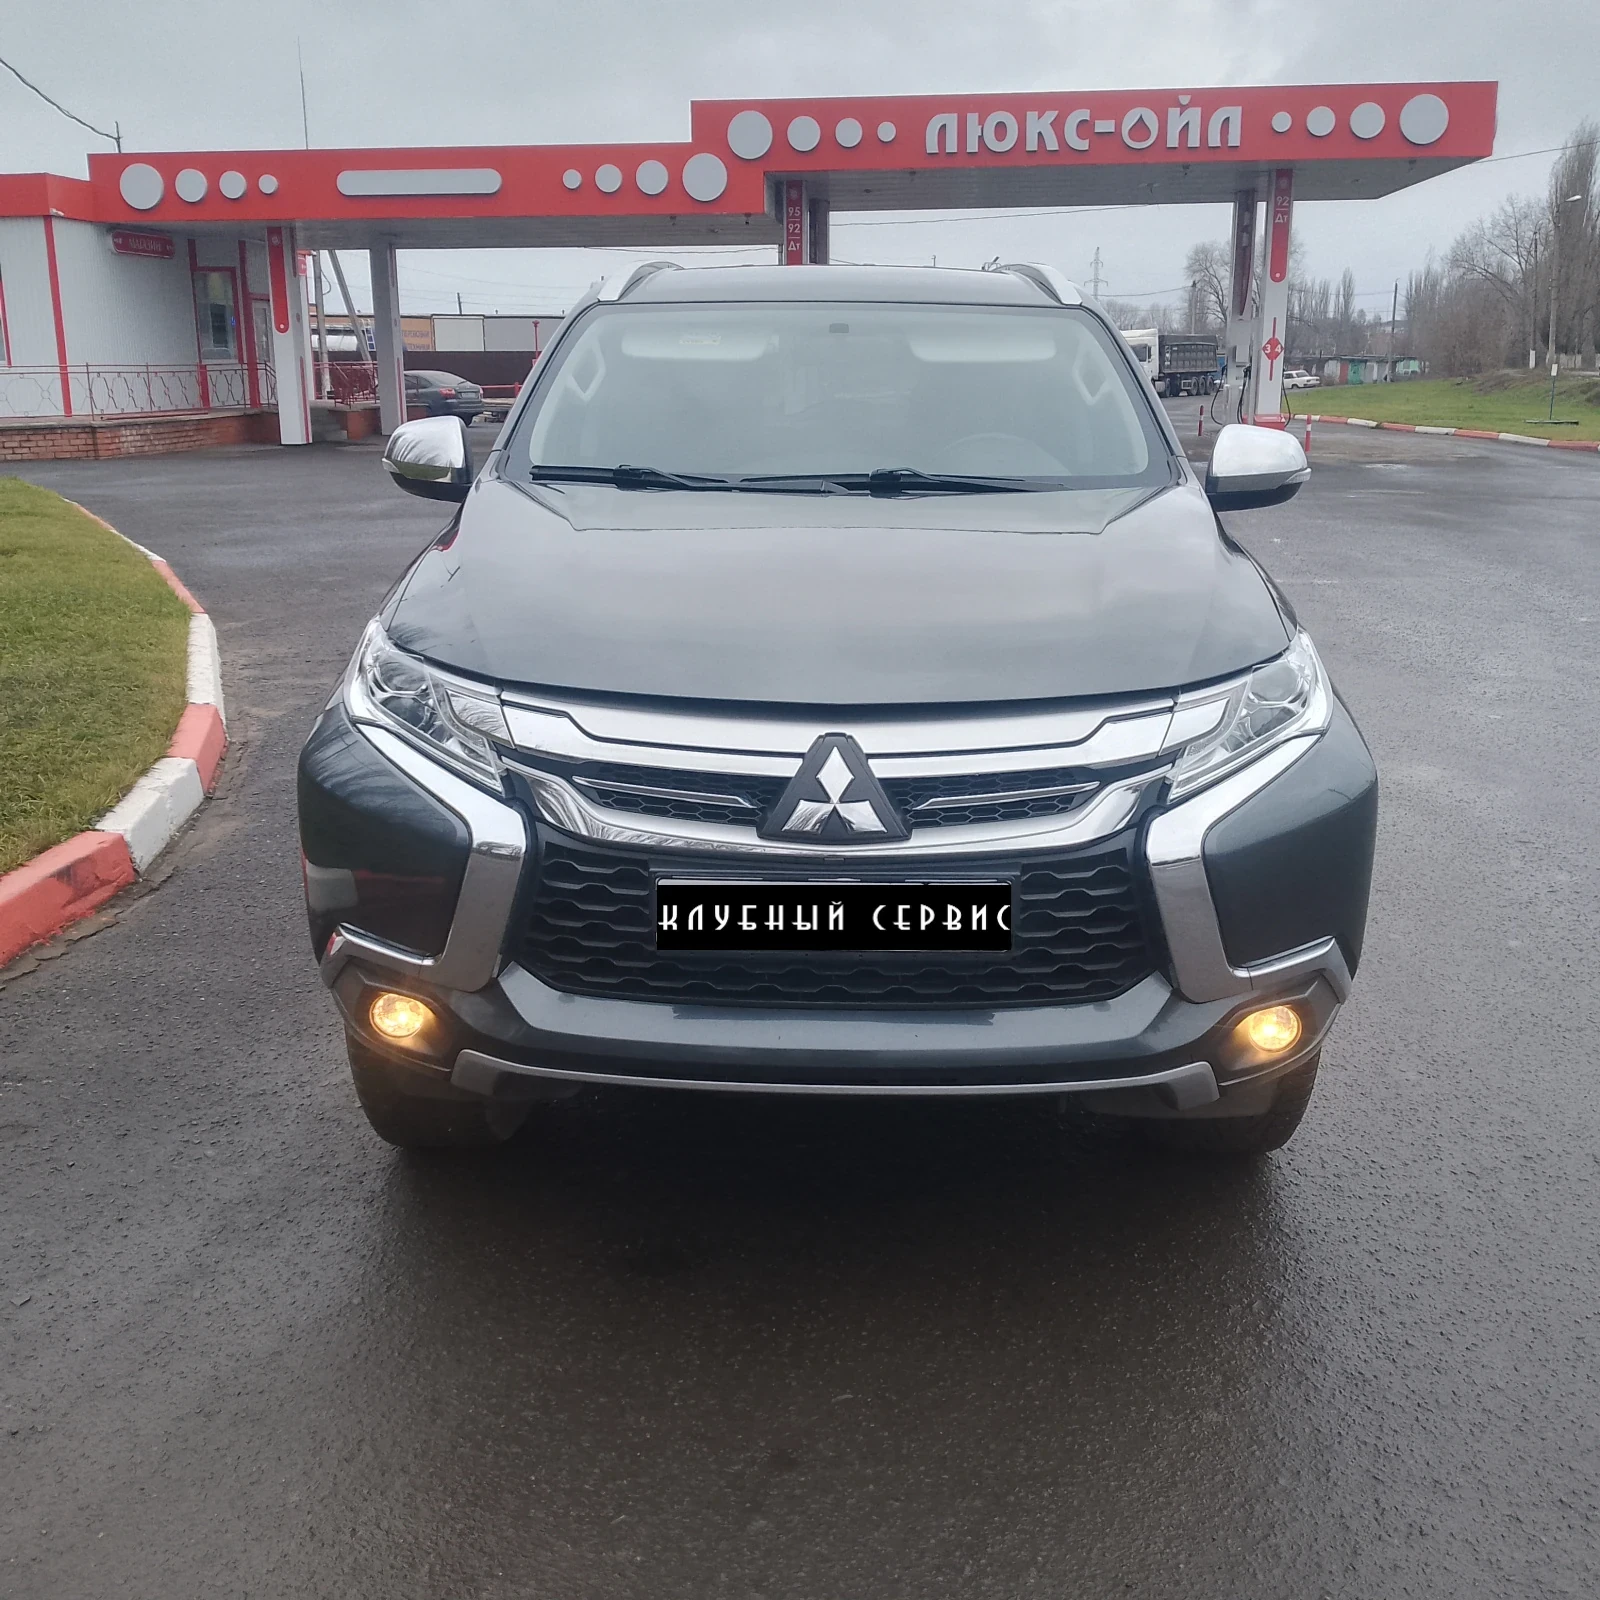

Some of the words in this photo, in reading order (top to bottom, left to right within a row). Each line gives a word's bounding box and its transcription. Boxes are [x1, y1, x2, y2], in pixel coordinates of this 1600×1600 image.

[925, 94, 1243, 155] ЛЮКС-ОЙЛ
[1276, 196, 1290, 206] 92
[788, 206, 801, 217] 95
[788, 223, 801, 233] 92
[1264, 343, 1271, 354] 3
[1274, 343, 1282, 354] 4
